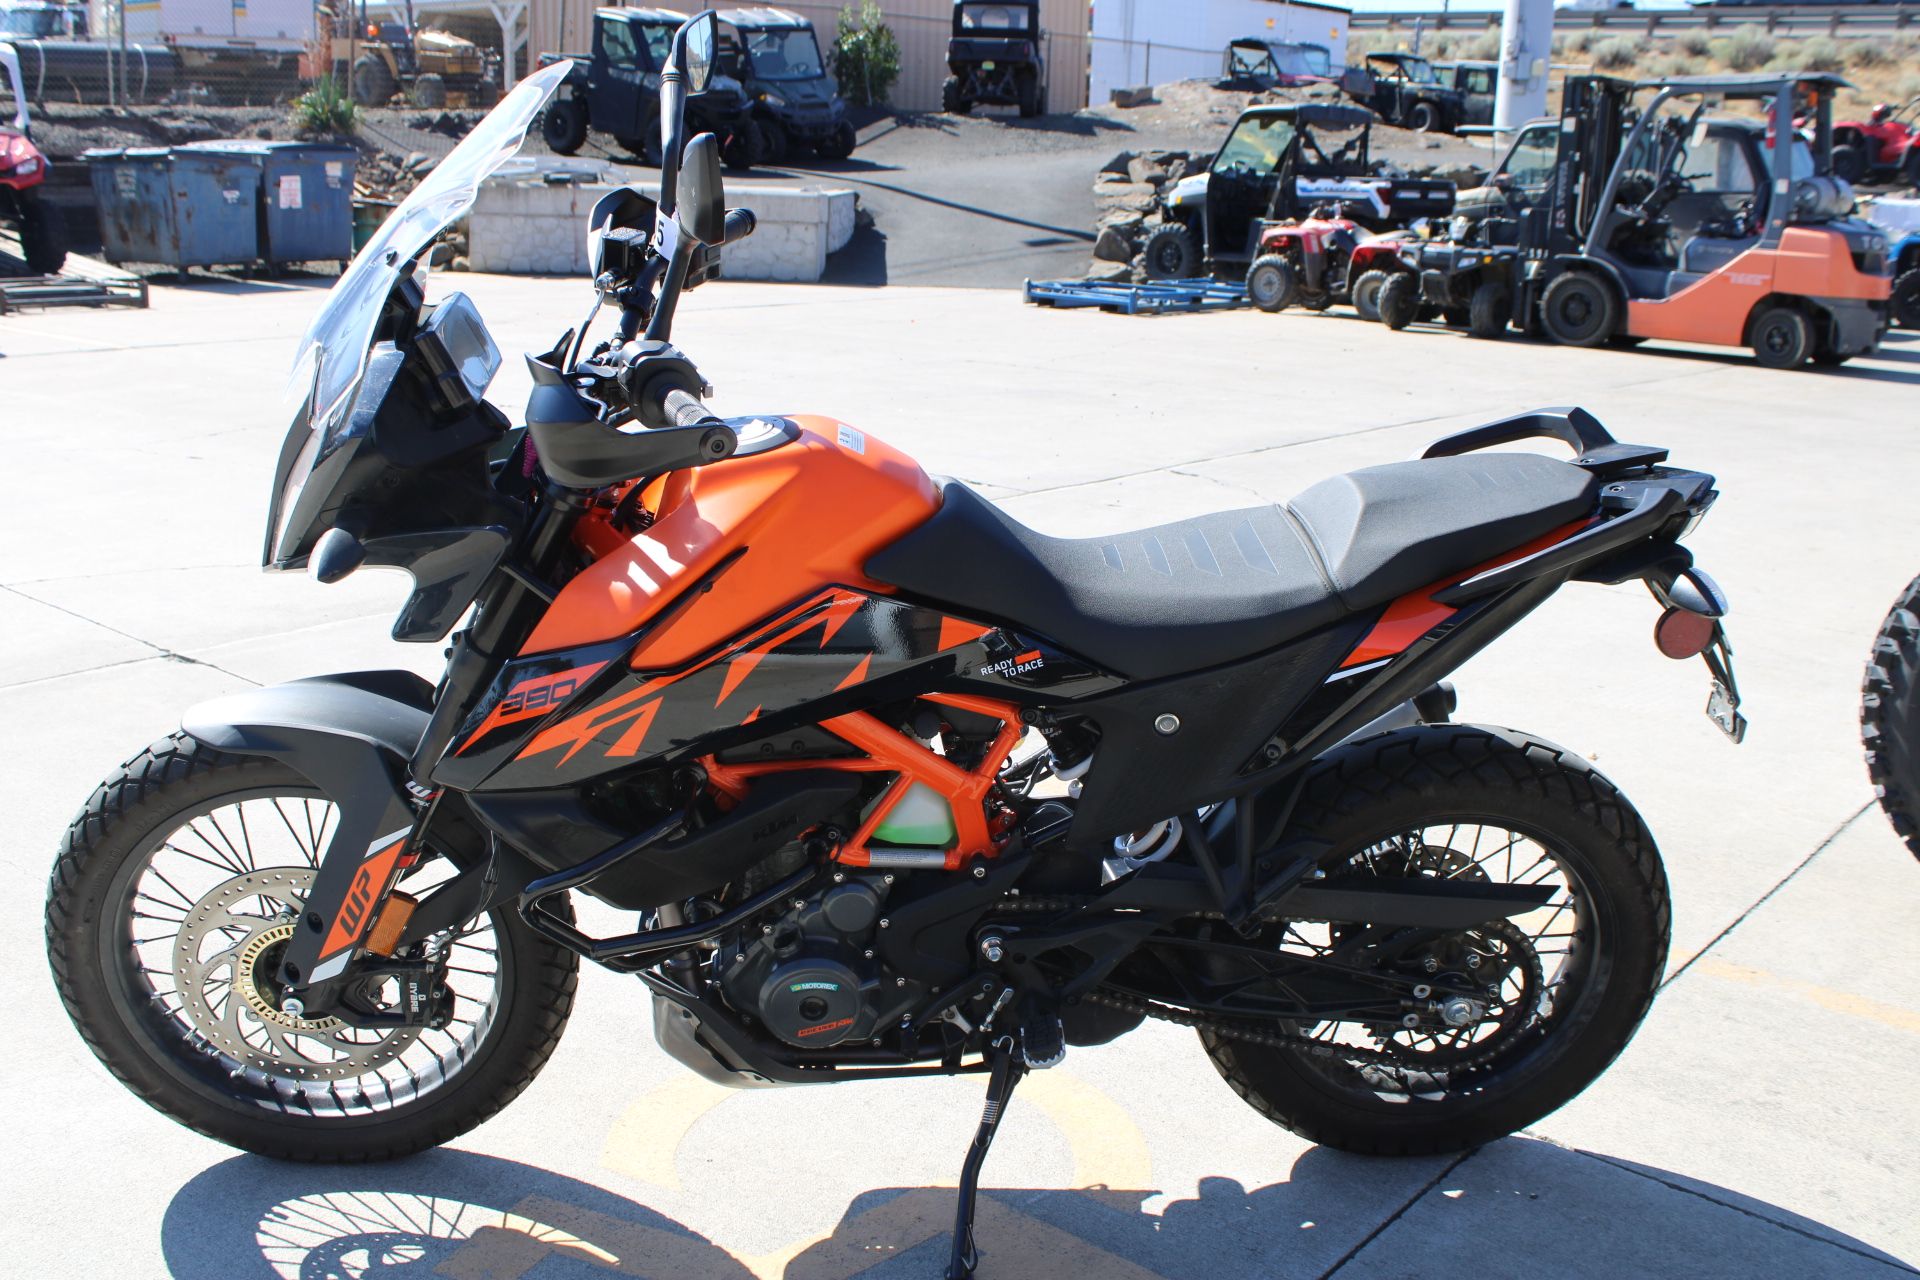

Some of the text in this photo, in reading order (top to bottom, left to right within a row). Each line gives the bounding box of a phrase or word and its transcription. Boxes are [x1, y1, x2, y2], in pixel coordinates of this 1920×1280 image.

[980, 659, 1013, 676] READY
[1002, 659, 1044, 678] TO RACE
[500, 678, 577, 717] 390
[801, 982, 839, 992] MOTOREX
